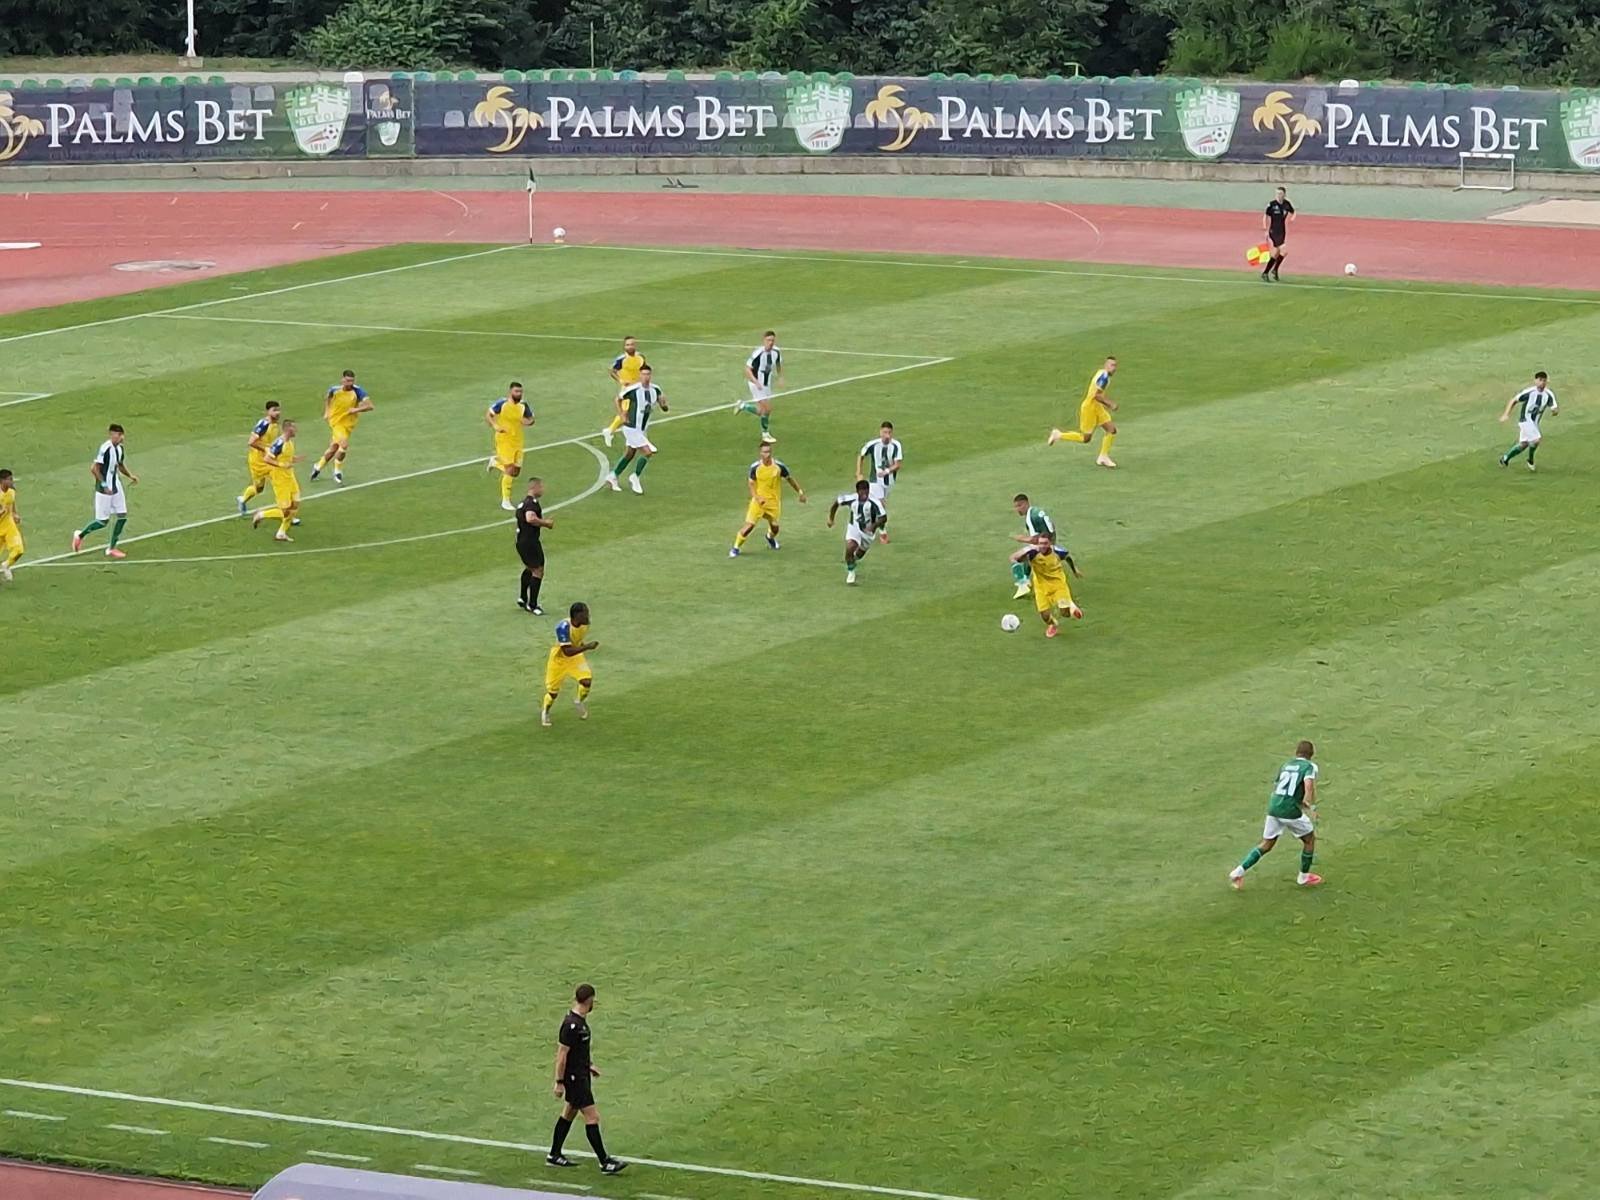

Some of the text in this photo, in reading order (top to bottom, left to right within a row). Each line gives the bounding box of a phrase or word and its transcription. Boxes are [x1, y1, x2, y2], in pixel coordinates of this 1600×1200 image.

[47, 103, 185, 148] PALMS
[194, 100, 273, 145] BET
[395, 108, 411, 119] BET
[546, 96, 774, 141] PALMS BET
[937, 96, 1163, 143] PALMS BET
[1324, 103, 1460, 149] PALMS
[1469, 106, 1548, 152] BET
[1275, 771, 1299, 796] 21
